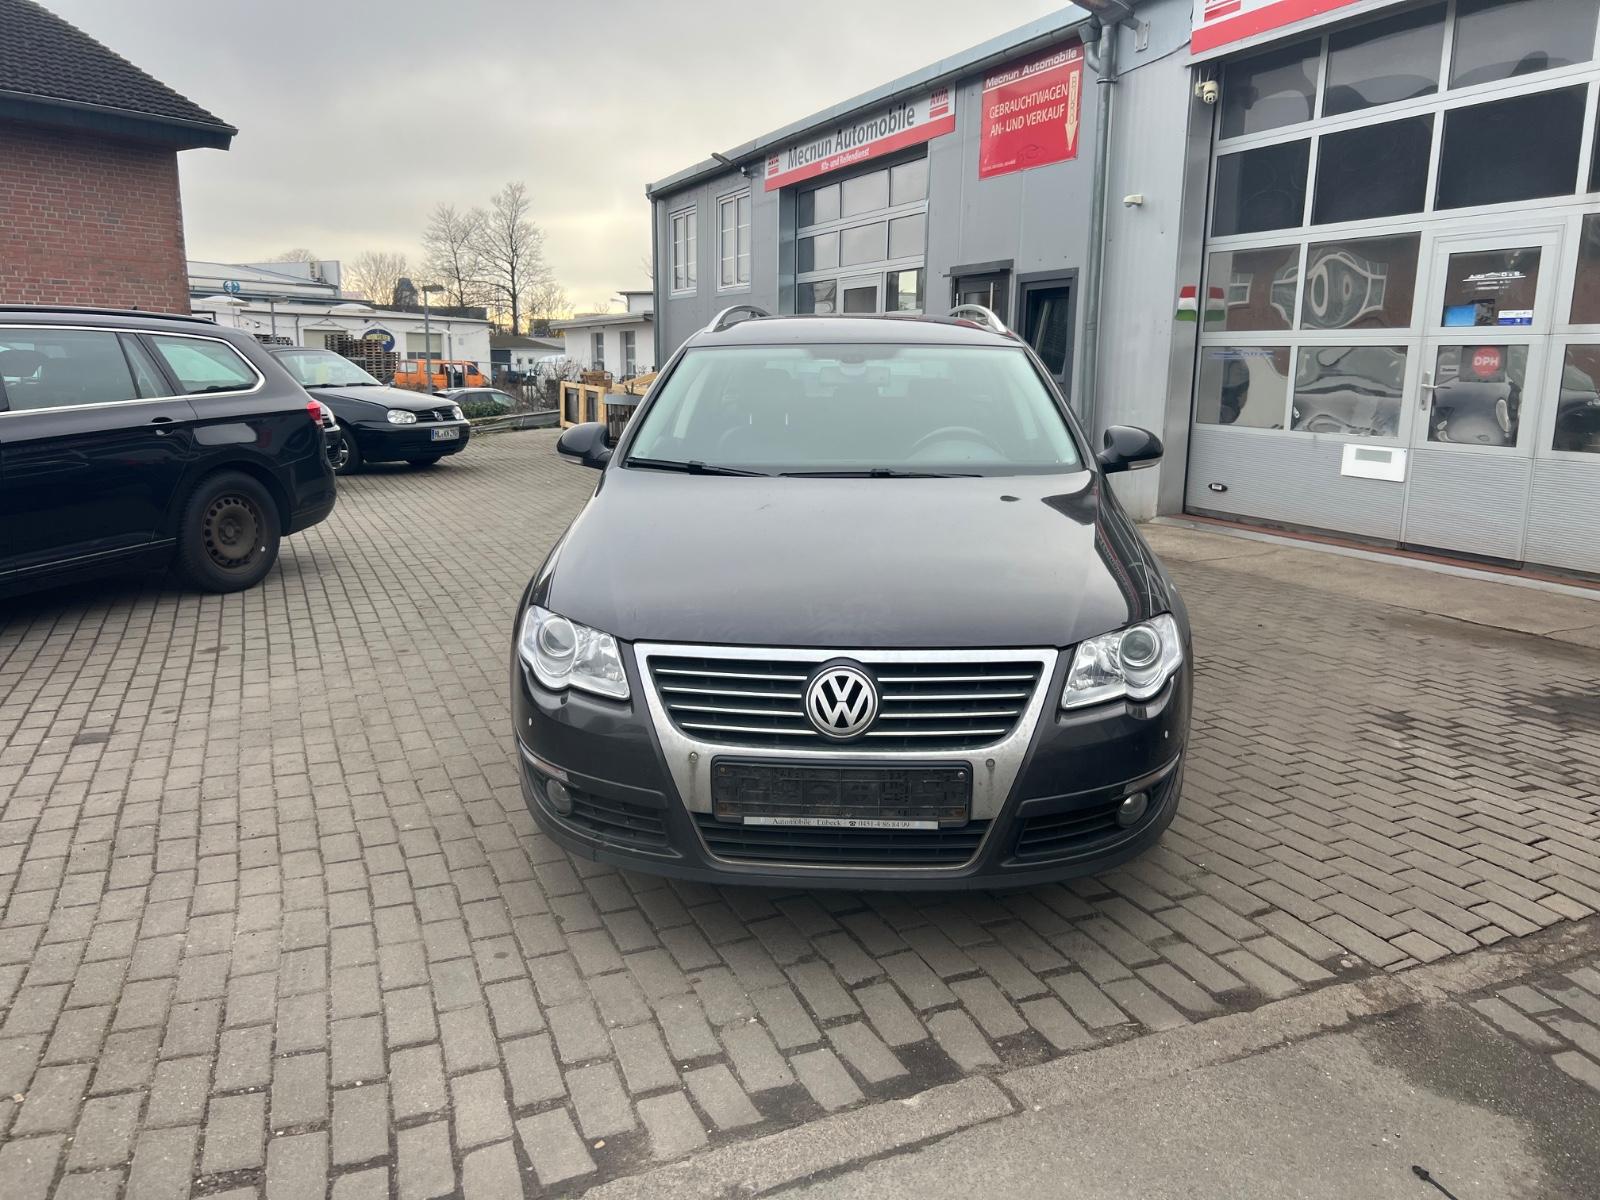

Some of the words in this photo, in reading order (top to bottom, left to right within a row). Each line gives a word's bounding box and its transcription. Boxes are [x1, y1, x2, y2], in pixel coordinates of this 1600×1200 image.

[985, 70, 1019, 88] Mecnun
[1022, 48, 1077, 76] Automobile
[989, 83, 1068, 119] GEBRAUCHTWAGEN
[788, 139, 832, 169] Mecnun
[834, 103, 915, 152] Automobile
[990, 122, 1005, 137] AN-
[1005, 116, 1024, 132] UND
[1026, 104, 1065, 127] VERKAUF
[1474, 356, 1499, 367] DPH
